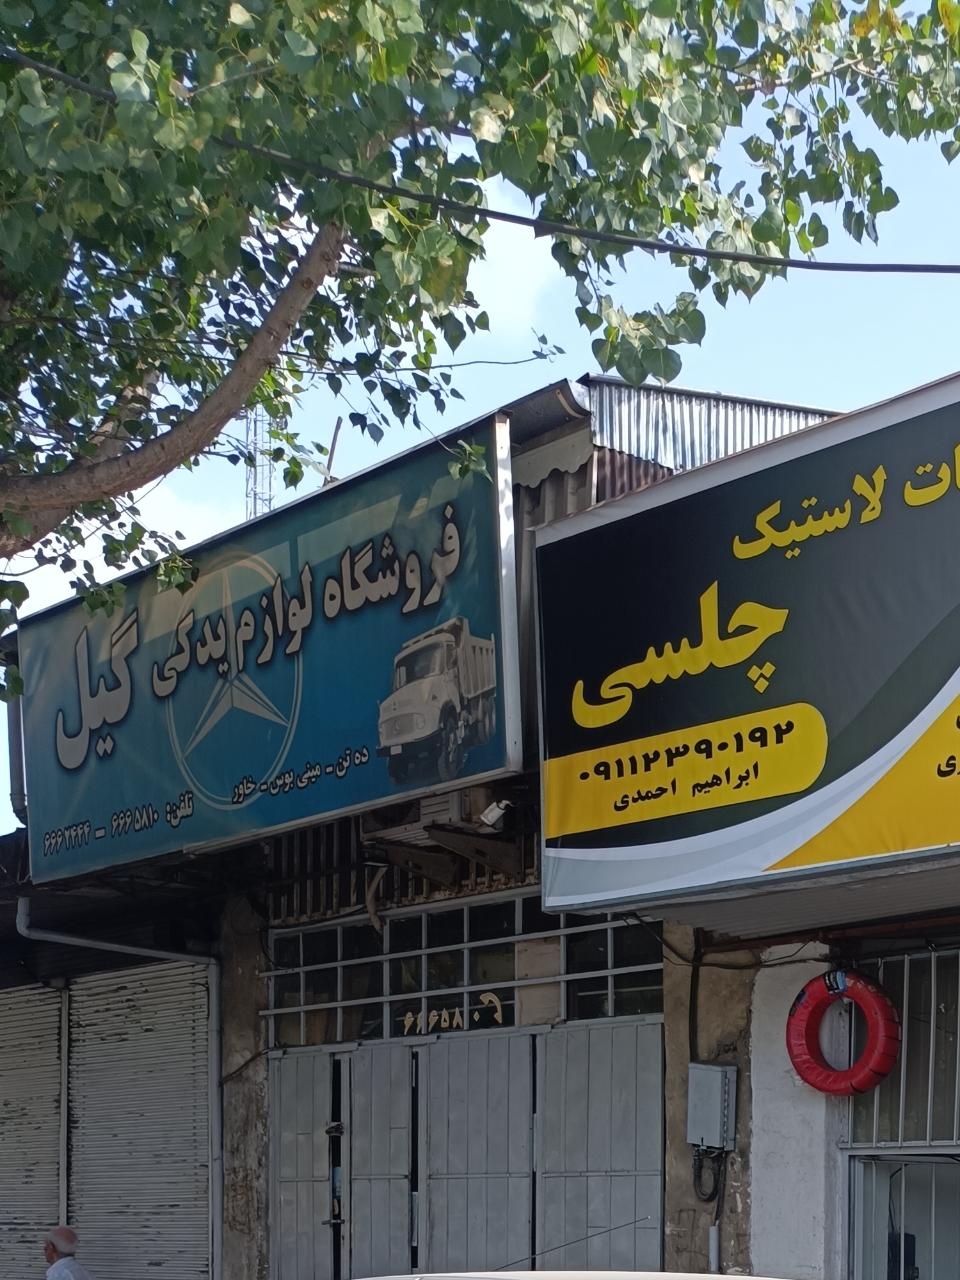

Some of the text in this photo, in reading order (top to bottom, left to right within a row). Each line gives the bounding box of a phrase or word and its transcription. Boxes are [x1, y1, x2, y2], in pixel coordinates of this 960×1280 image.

[732, 465, 888, 560] لاستیک
[56, 504, 460, 770] فروشگاه لوازم یدکی گیل
[571, 580, 789, 729] چلسی
[579, 720, 795, 781] ۰۹۱۱۲۳۹۰۱۹۲
[613, 760, 759, 812] ابراهیم احمدی
